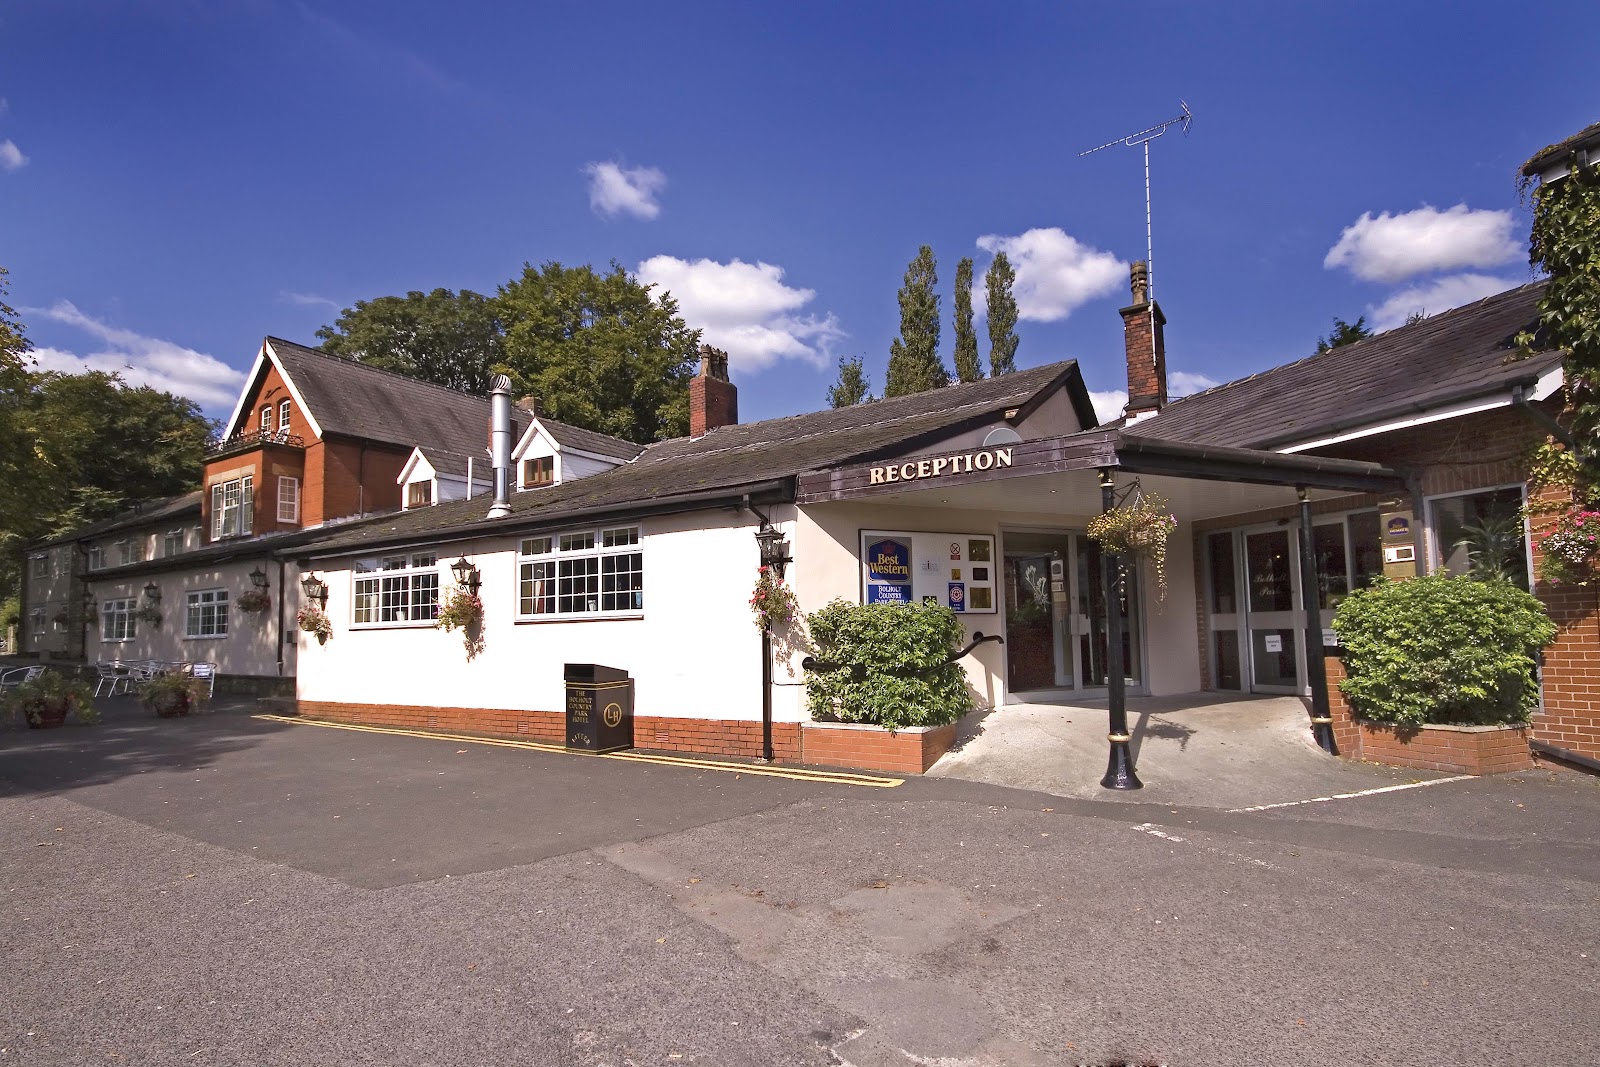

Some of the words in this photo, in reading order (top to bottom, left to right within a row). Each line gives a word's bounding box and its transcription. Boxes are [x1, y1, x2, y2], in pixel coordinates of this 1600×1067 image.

[869, 448, 1013, 486] RECEPTION
[878, 554, 899, 565] Best
[870, 562, 908, 574] Western
[568, 703, 593, 711] COUNTRY
